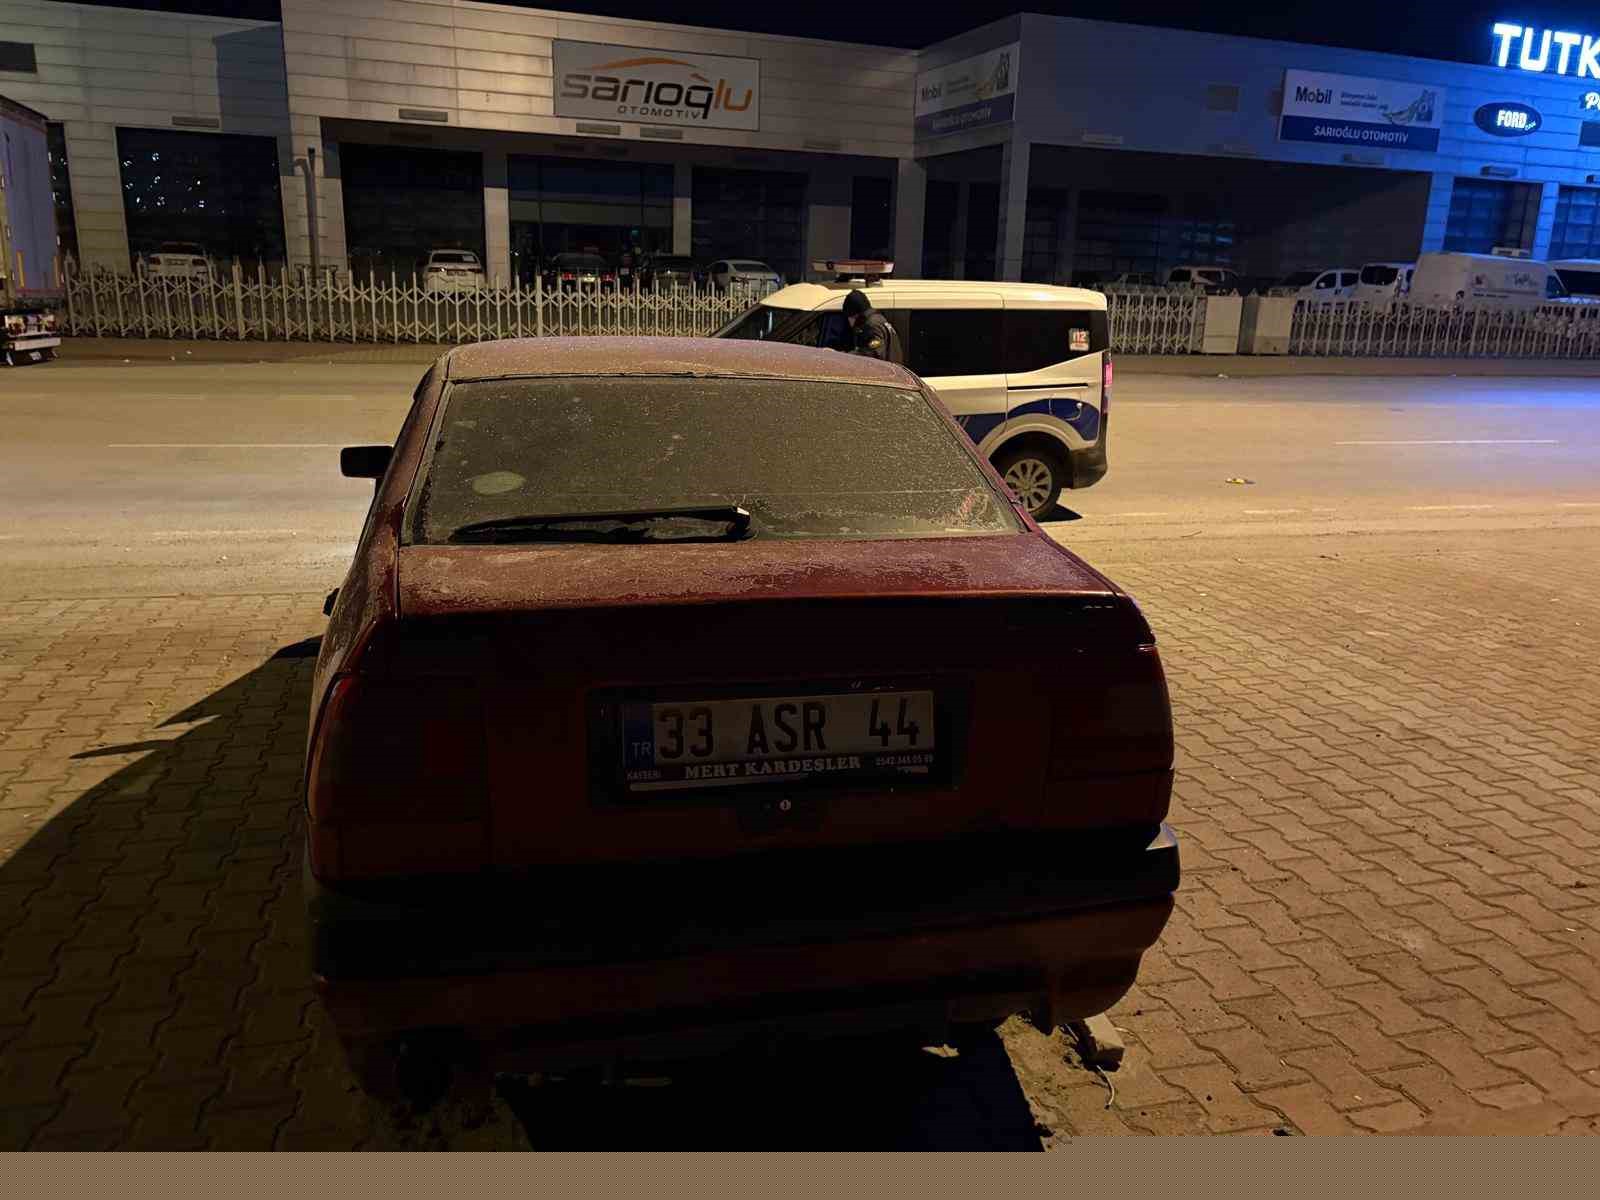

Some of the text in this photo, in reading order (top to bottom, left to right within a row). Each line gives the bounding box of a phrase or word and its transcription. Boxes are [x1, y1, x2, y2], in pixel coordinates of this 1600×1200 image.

[1295, 85, 1333, 105] Mobil
[1496, 108, 1528, 129] FORD
[657, 698, 920, 760] 33 ASR 44
[631, 741, 652, 761] TR
[685, 763, 739, 779] MERT
